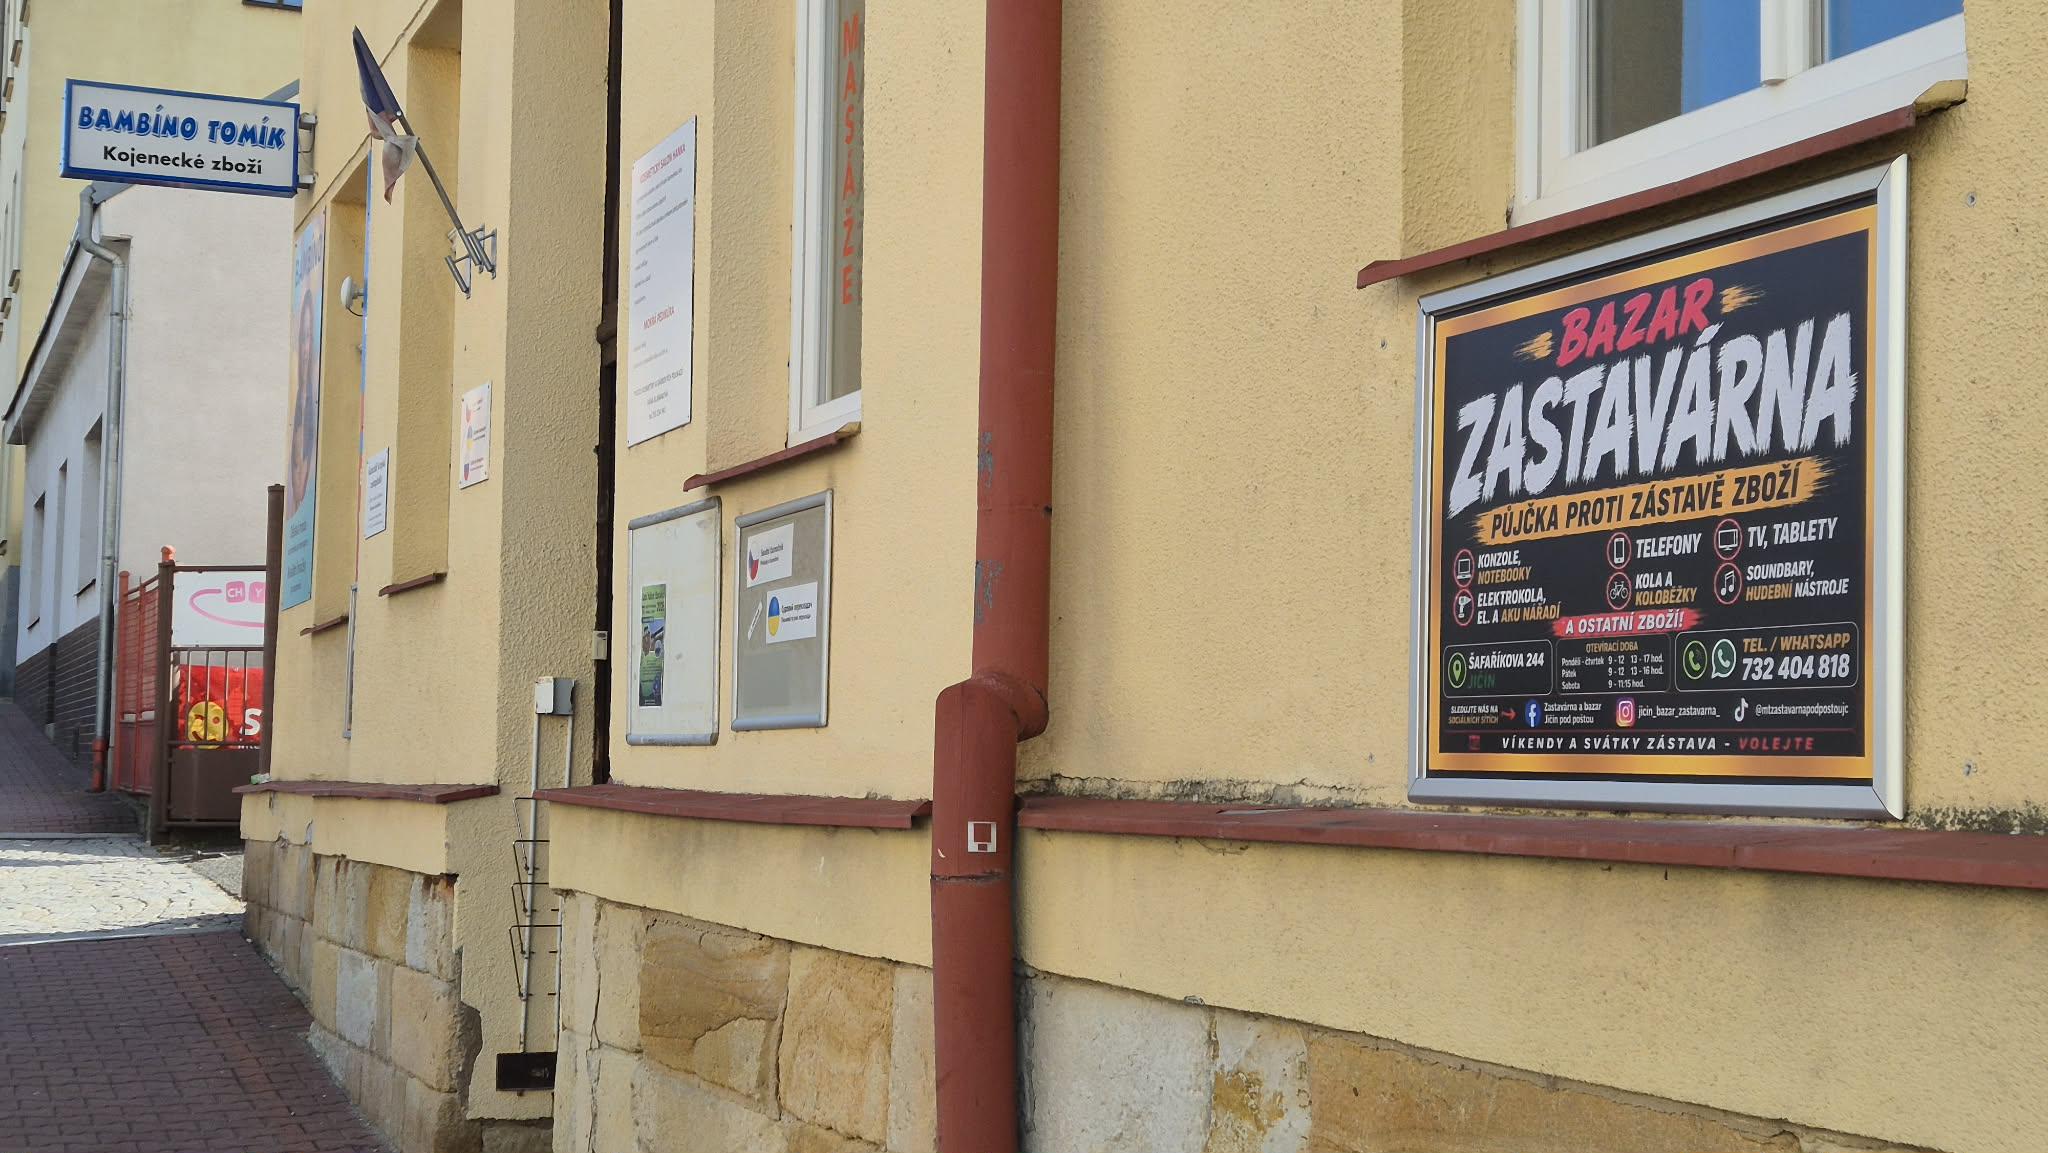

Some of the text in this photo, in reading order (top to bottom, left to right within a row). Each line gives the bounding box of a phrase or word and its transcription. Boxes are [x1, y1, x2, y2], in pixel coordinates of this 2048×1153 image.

[78, 104, 286, 150] BAMBÍNO TOMÍK
[103, 145, 262, 174] Kojenecké zboží
[842, 14, 859, 305] MASÁŽE
[1556, 278, 1714, 367] BAZAR
[1447, 310, 1858, 519] ZASTAVÁRNA
[1491, 462, 1802, 539] PŮJČKA PROTI ZÁSTAVĚ ZBOŽÍ
[1747, 517, 1838, 549] TV, TABLETY
[1636, 533, 1702, 558] TELEFONY
[1477, 550, 1521, 568] KONZOLE,
[1477, 566, 1532, 585] NOTEBOOKY
[1635, 571, 1673, 589] KOLA A
[1746, 559, 1815, 581] SOUNDBARY,
[1477, 588, 1547, 607] ELEKTROKOLA,
[1635, 586, 1698, 606] KOLOBĚŽKY
[1746, 577, 1850, 601] HUDEBNÍ NÁSTROJE
[1477, 601, 1561, 625] EL. A AKU NÁŘADÍ
[1565, 611, 1684, 634] A OSTATNÍ ZBOŽÍ!
[1586, 640, 1639, 654] OTEVÍRACÍ DOBA
[1743, 638, 1767, 653] TEL.
[1780, 633, 1851, 651] WHATSAPP
[1468, 651, 1545, 670] ŠAFAŘÍKOVA 244
[1608, 655, 1613, 665] 9
[1618, 655, 1625, 664] 12
[1630, 655, 1638, 664] 13
[1643, 654, 1650, 663] 17
[1742, 653, 1850, 681] 732 404 818
[1608, 667, 1613, 676] 9
[1618, 667, 1625, 676] 12
[1630, 666, 1638, 675] 13
[1643, 666, 1650, 675] 16
[1561, 681, 1581, 690] Sobota
[1608, 680, 1613, 689] 9
[1544, 702, 1578, 711] Zastavárna
[1584, 702, 1602, 711] bazar
[1560, 714, 1572, 725] pod
[1502, 735, 1563, 749] VÍKENDY
[1569, 738, 1577, 749] A
[1584, 735, 1640, 750] SVÁTKY
[1647, 735, 1717, 750] ZÁSTAVA
[1738, 737, 1814, 750] VOLEJTE
